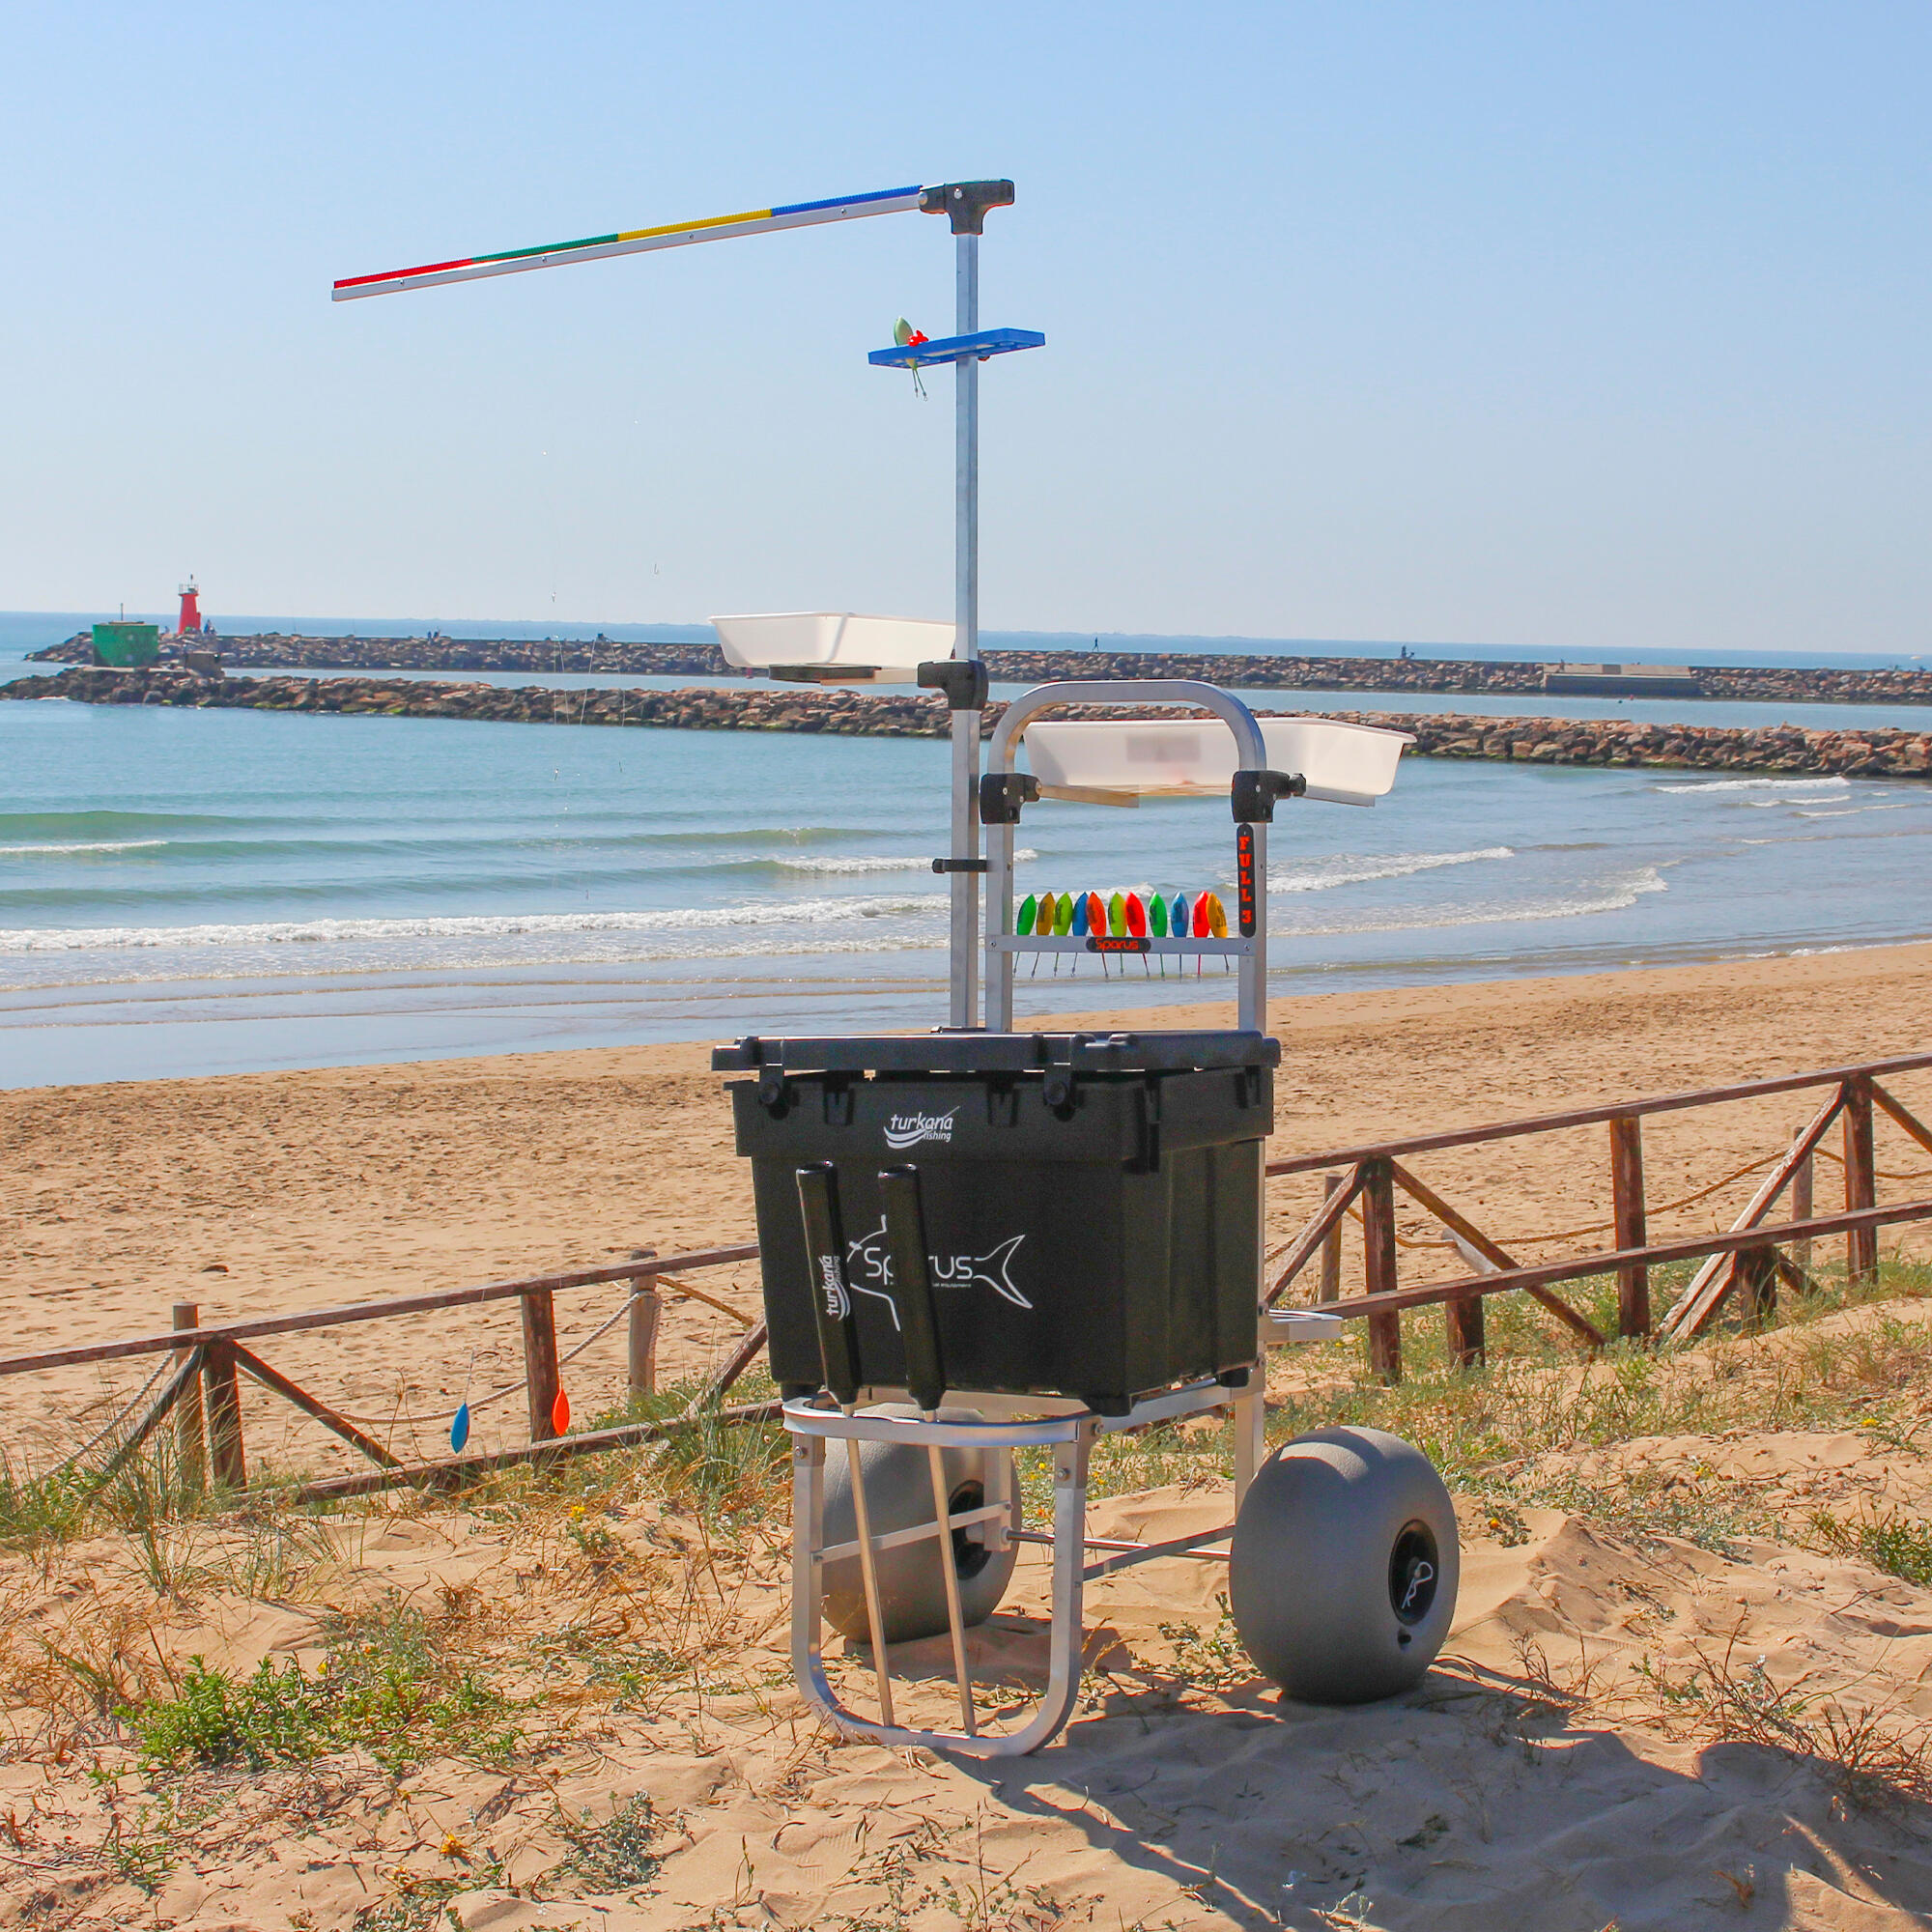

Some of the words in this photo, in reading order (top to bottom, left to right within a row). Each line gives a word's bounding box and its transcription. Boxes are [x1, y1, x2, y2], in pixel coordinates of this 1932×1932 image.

[1238, 836, 1252, 902] FULL
[1240, 909, 1252, 923] 3
[1095, 937, 1139, 951] Sparus
[890, 1111, 953, 1130] turkana
[923, 1130, 952, 1143] fishing
[864, 1247, 973, 1286] Spus
[822, 1255, 839, 1316] turkana
